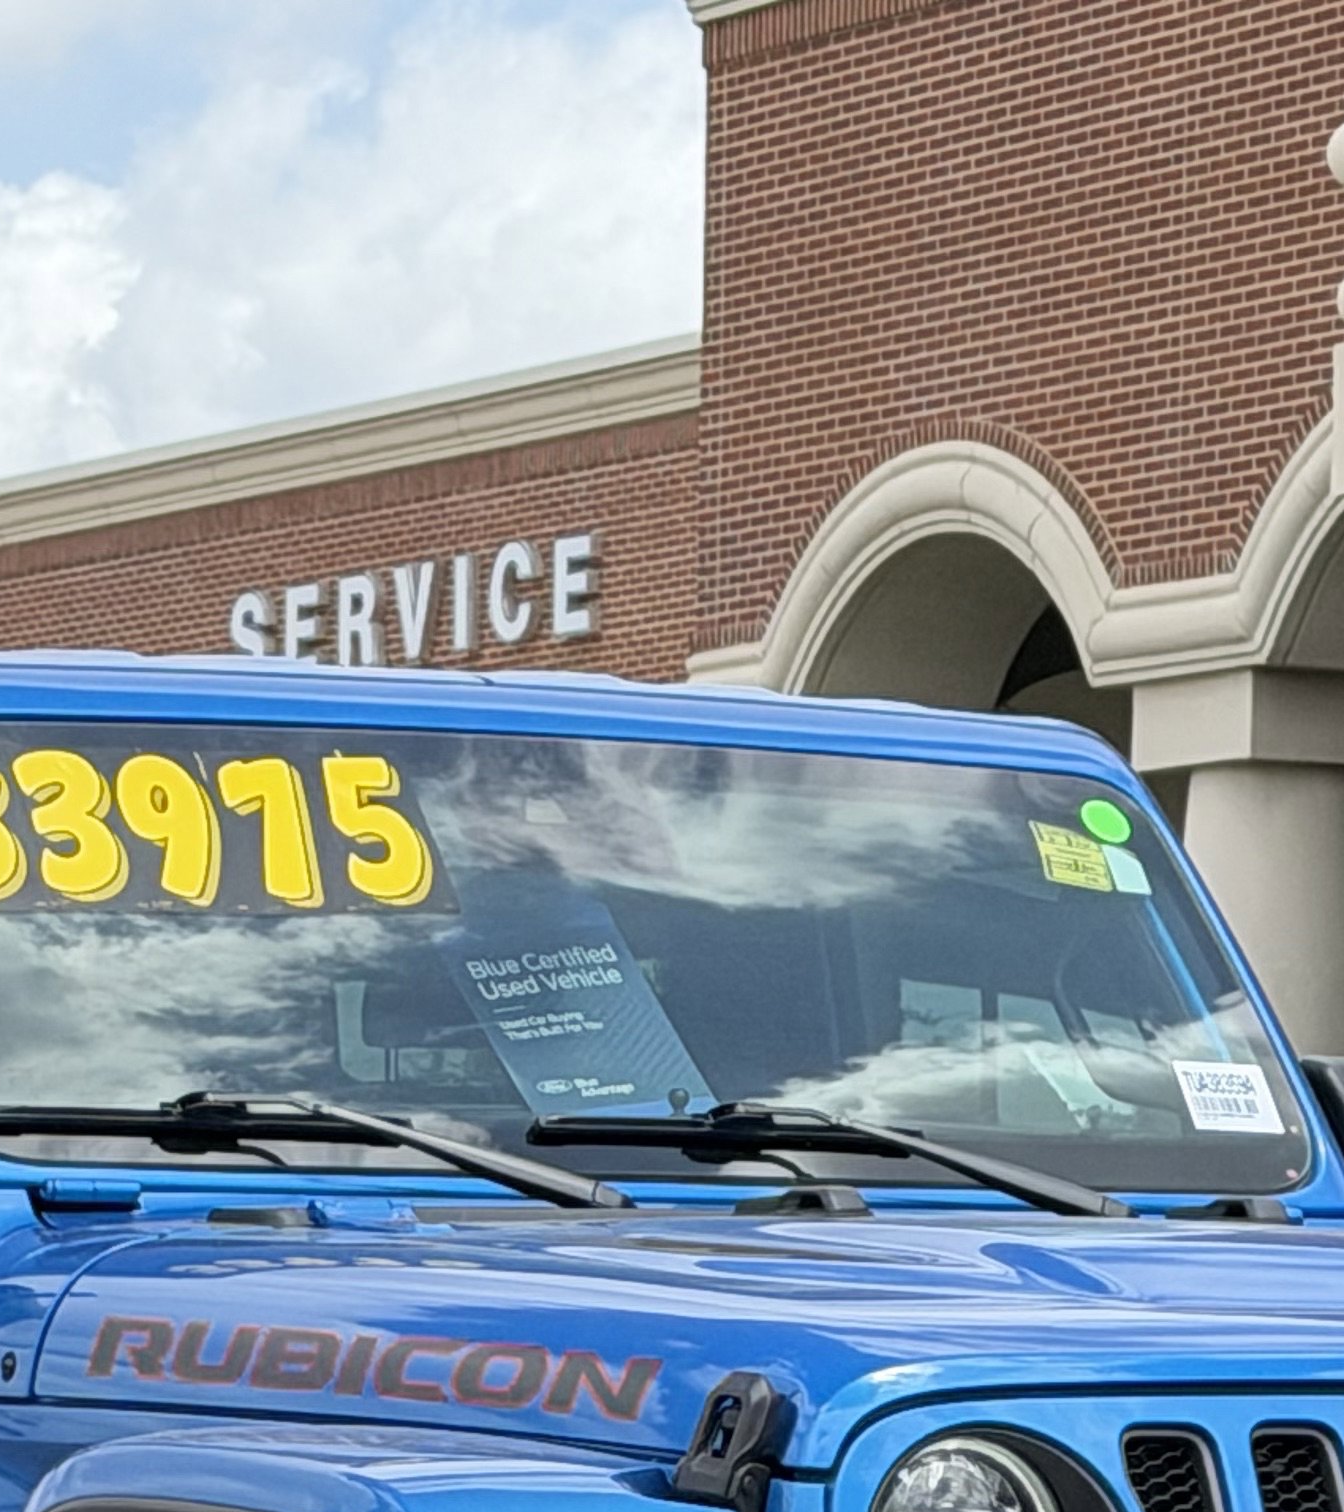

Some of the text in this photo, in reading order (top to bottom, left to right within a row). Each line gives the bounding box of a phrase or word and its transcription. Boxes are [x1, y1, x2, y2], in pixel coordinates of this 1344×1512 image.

[229, 533, 596, 667] SERVICE
[465, 944, 618, 981] Blue Certified
[476, 966, 623, 1001] Used Vehicle
[85, 1315, 662, 1422] RUBICON
